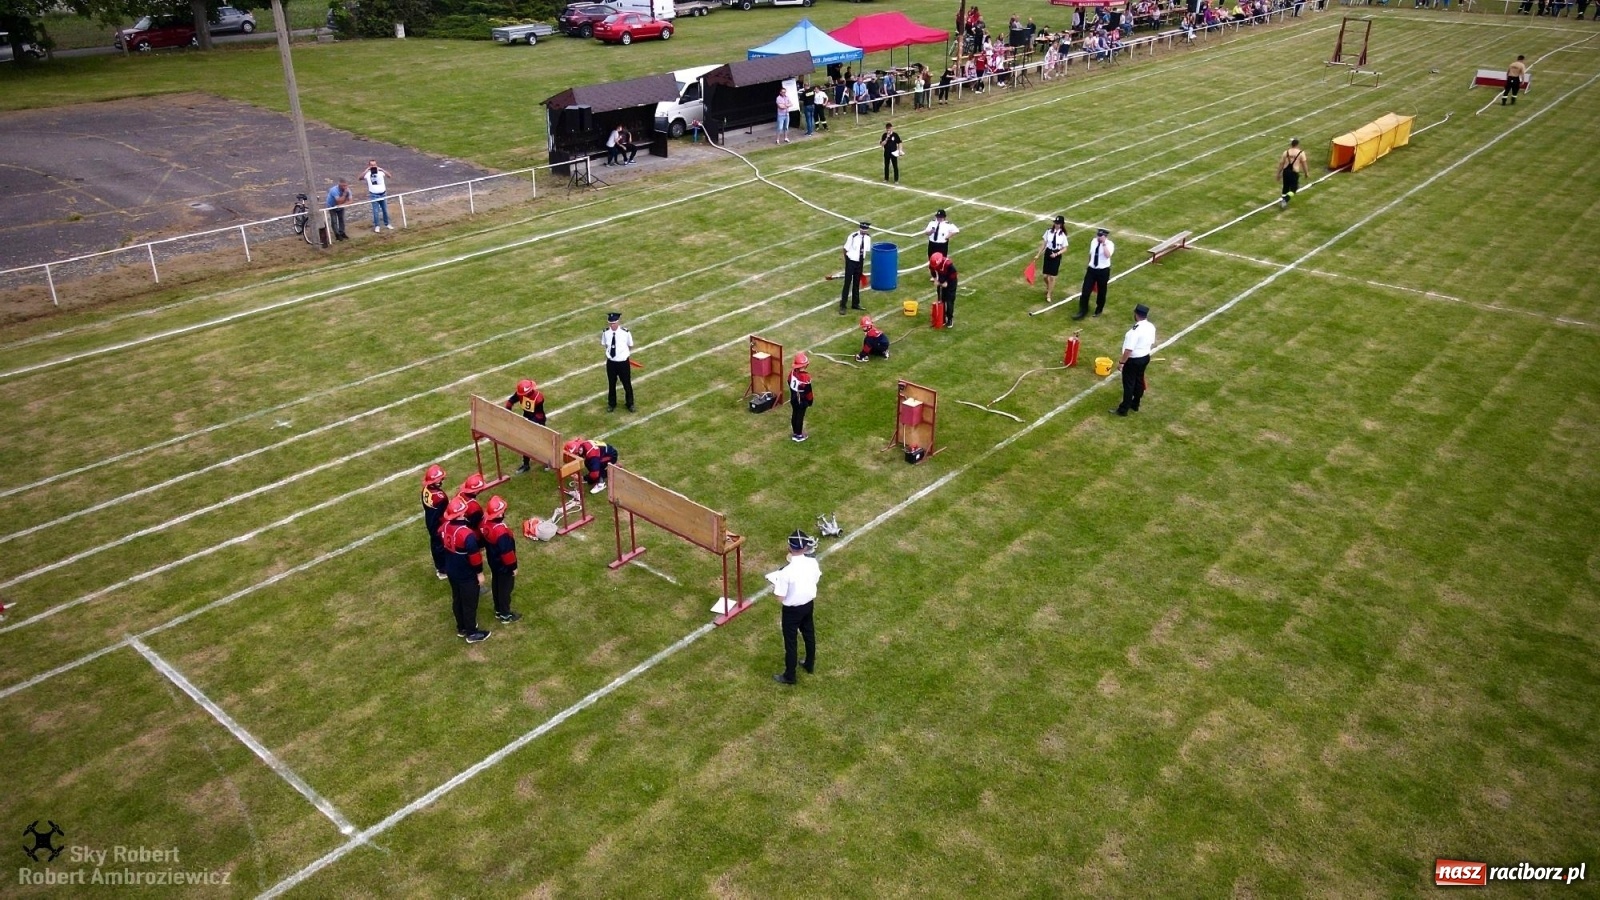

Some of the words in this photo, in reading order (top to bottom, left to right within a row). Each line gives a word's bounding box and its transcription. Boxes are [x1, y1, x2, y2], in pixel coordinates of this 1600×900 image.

[793, 380, 797, 388] 1
[524, 400, 531, 410] 9
[424, 491, 430, 503] 8
[445, 535, 452, 549] 3
